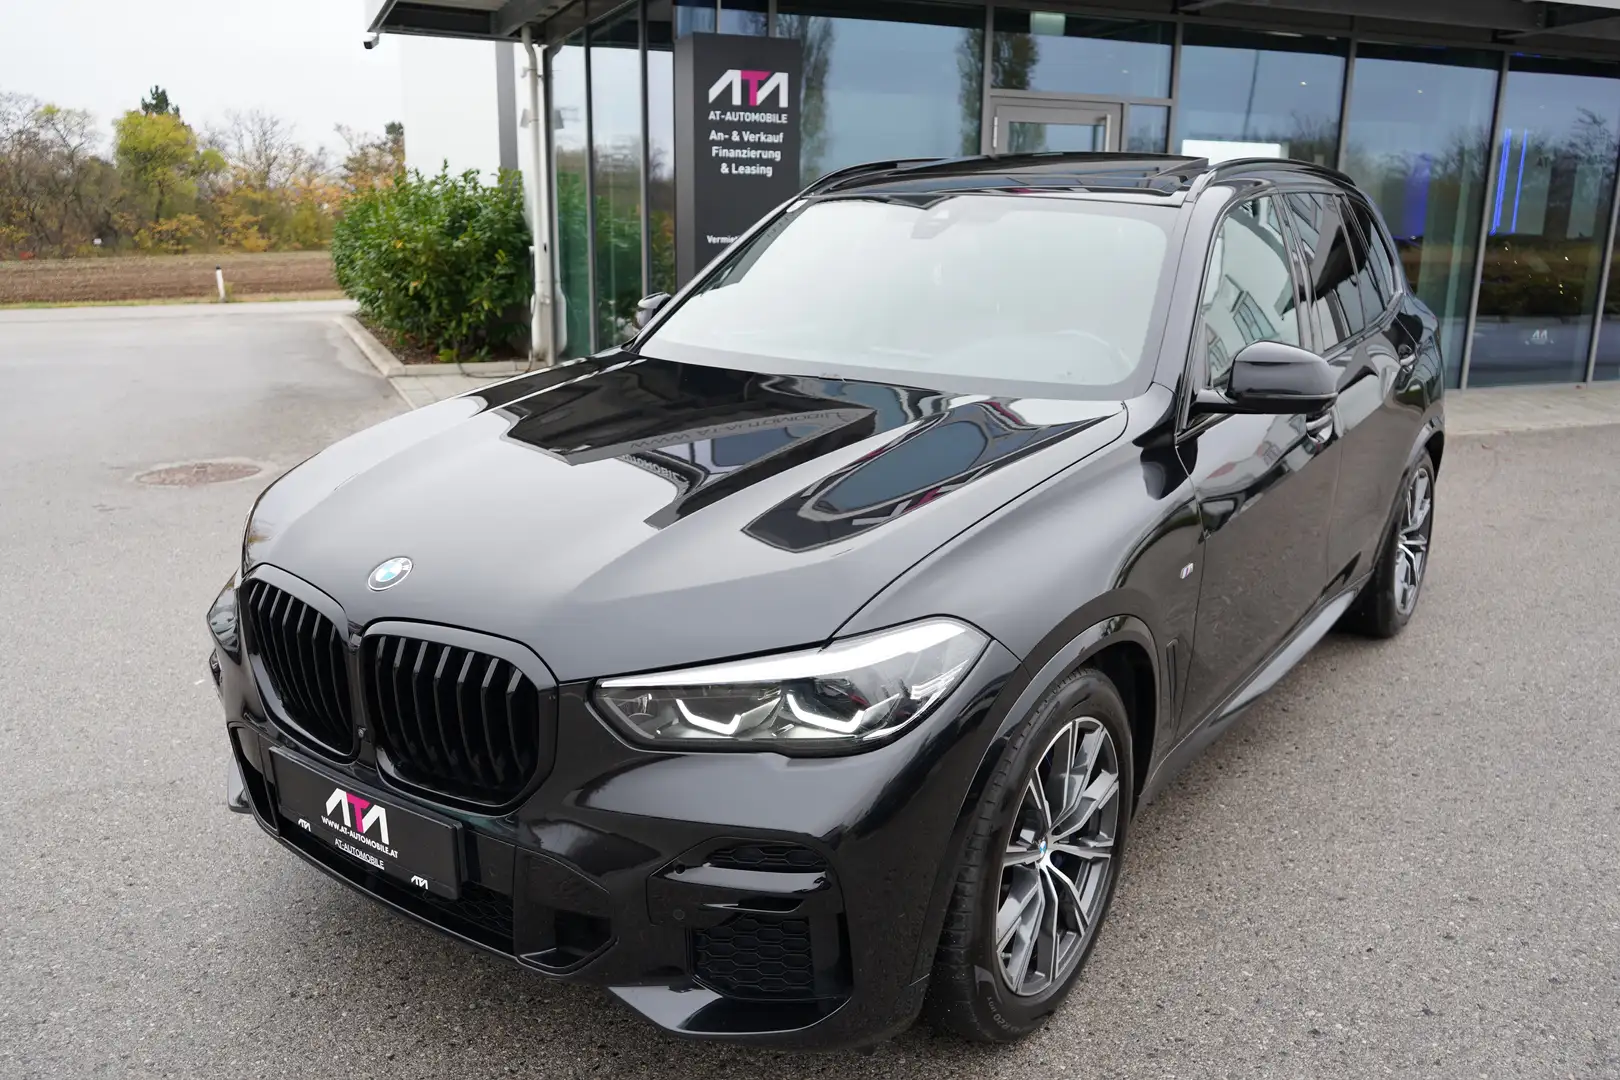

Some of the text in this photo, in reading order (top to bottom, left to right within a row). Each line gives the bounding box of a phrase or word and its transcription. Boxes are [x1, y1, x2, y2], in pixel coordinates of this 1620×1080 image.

[708, 69, 789, 108] ATA
[708, 110, 788, 124] AT-AUTOMOBILE
[709, 129, 784, 143] An- & Verkauf
[711, 146, 781, 162] Finanzierung
[720, 162, 773, 177] & Leasing
[325, 788, 390, 845] ATA
[320, 815, 399, 859] WWW.AT-AUTOMOBILE.AT
[334, 838, 385, 870] AT-AUTOMOBILE
